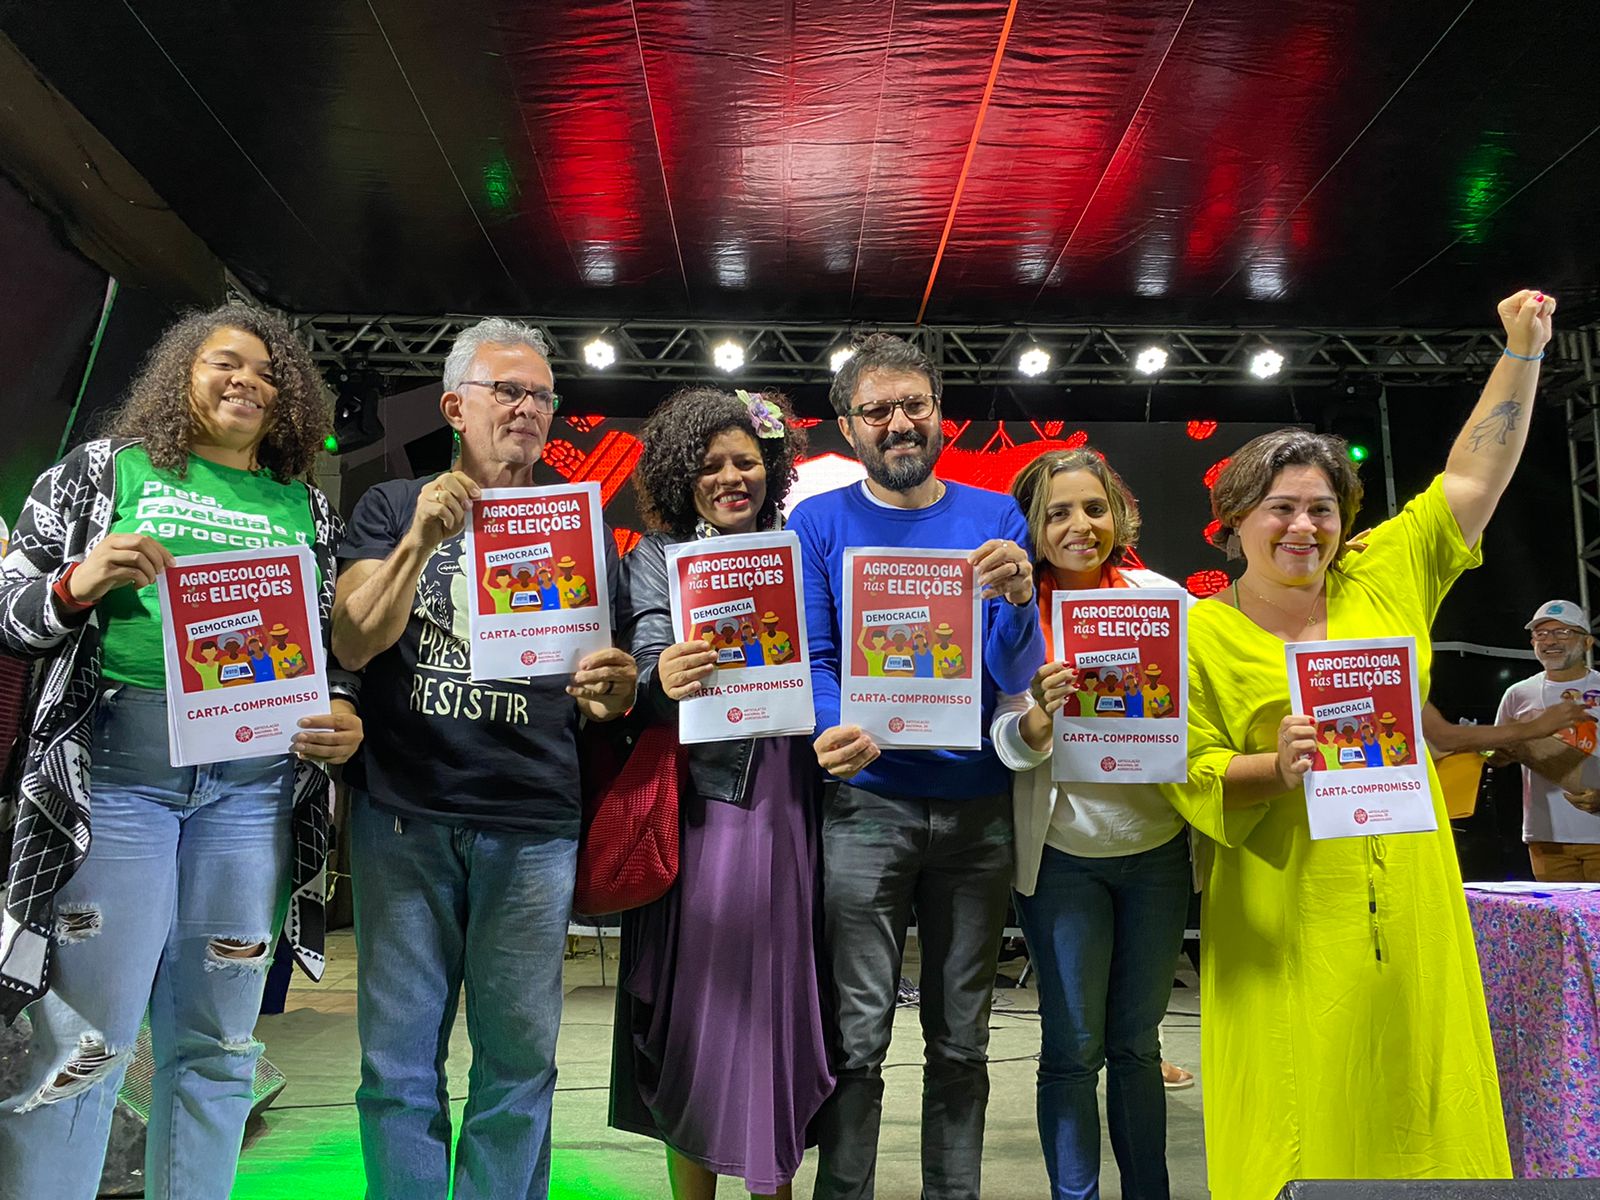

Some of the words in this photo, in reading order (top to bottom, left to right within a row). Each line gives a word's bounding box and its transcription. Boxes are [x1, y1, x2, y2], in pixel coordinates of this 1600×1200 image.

[142, 481, 222, 508] Preta,
[482, 500, 580, 518] AGROECOLOGIA
[135, 520, 288, 548] Agroecolo
[142, 503, 266, 530] Favelada
[273, 524, 288, 536] e
[295, 531, 306, 545] d
[484, 523, 504, 534] nas
[508, 514, 581, 536] ELEIÇÕES
[488, 546, 549, 563] DEMOCRACIA
[688, 554, 784, 575] AGROECOLOGIA
[179, 563, 291, 587] AGROECOLOGIA
[688, 579, 708, 590] nas
[711, 568, 784, 590] ELEIÇÕES
[863, 562, 963, 578] AGROECOLOGIA
[182, 590, 207, 603] nas
[209, 578, 293, 602] ELEIÇÕES
[863, 581, 884, 591] nas
[888, 578, 962, 599] ELEIÇÕES
[694, 602, 752, 620] DEMOCRACIA
[865, 611, 927, 622] DEMOCRACIA
[1072, 606, 1170, 619] AGROECOLOGIA
[190, 614, 258, 636] DEMOCRACIA
[480, 622, 600, 640] CARTA-COMPROMISSO
[1074, 624, 1096, 634] nas
[1098, 619, 1170, 640] ELEIÇÕES
[418, 622, 470, 668] PRES
[1079, 652, 1137, 665] DEMOCRACIA
[1308, 654, 1400, 672] AGROECOLOGIA
[1310, 677, 1330, 687] nas
[1333, 668, 1401, 690] ELEIÇÕES
[187, 691, 319, 720] CARTA-COMPROMISSO
[410, 674, 528, 724] RESISTIR
[850, 693, 972, 704] CARTA-COMPROMISSO
[1316, 701, 1372, 718] DEMOCRACIA
[1062, 733, 1179, 744] CARTA-COMPROMISSO
[1315, 781, 1421, 797] CARTA-COMPROMISSO
